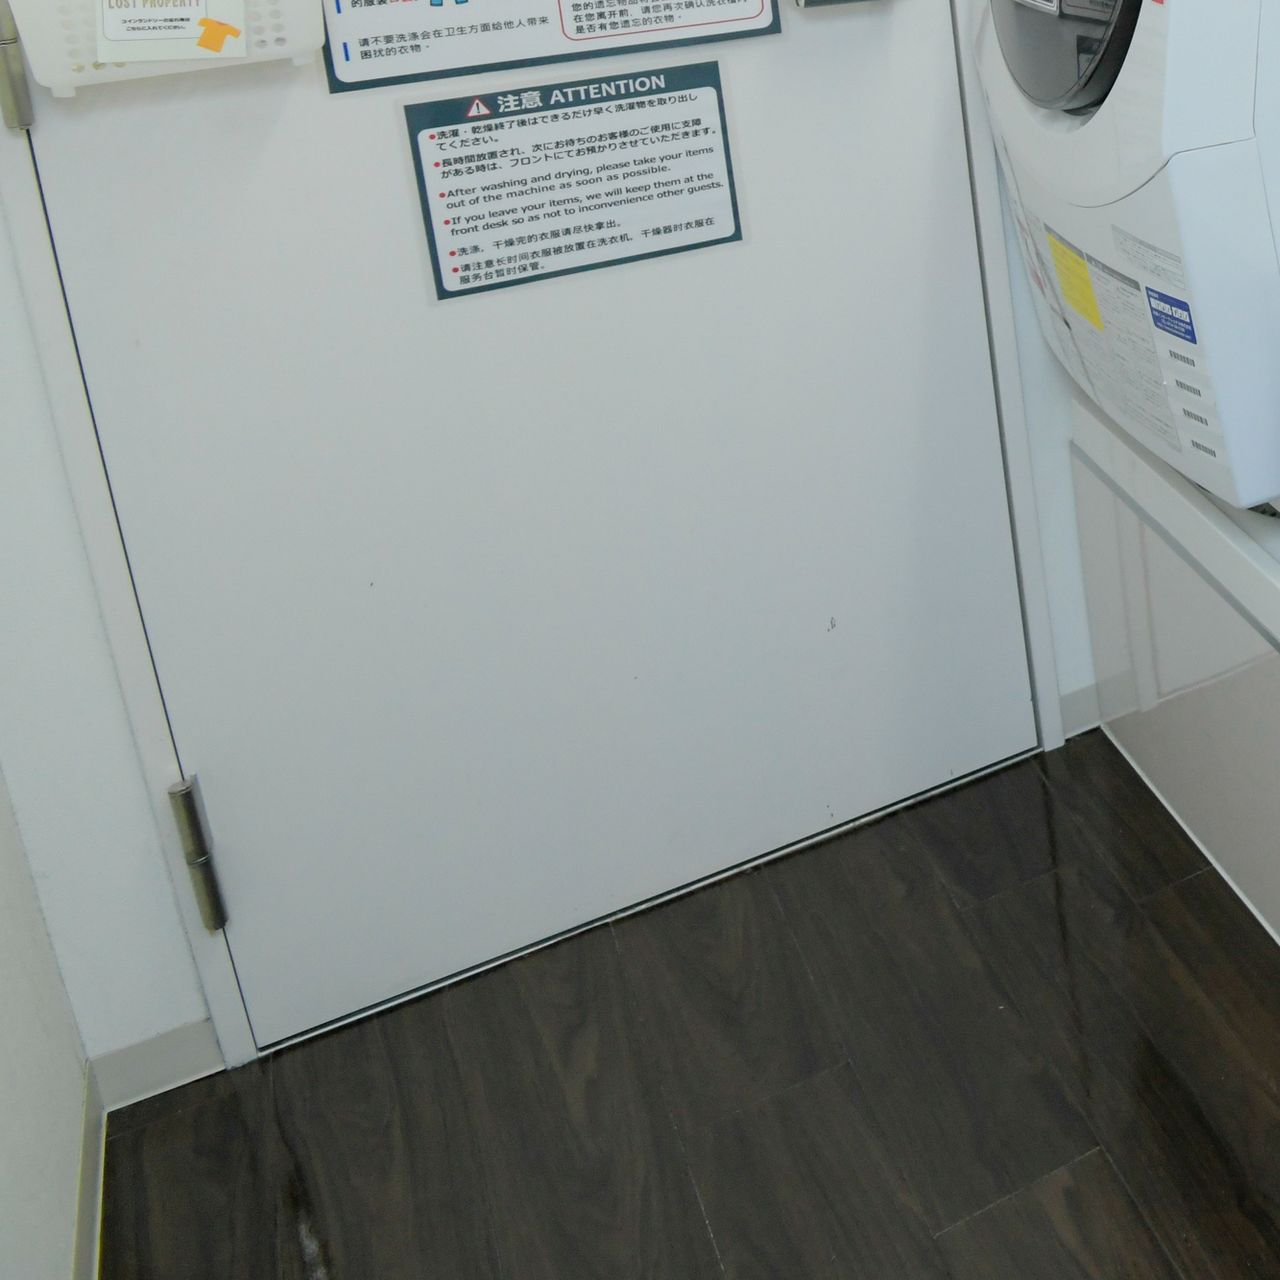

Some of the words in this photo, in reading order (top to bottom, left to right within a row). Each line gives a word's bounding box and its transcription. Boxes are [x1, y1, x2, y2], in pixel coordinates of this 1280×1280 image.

[575, 14, 682, 34] 是否有您遗忘的衣物。
[360, 44, 430, 60] 困扰的衣物。
[497, 90, 543, 112] 注意
[550, 75, 666, 105] ATTENTION
[447, 187, 476, 198] After
[481, 178, 527, 192] washing
[531, 172, 551, 183] and
[554, 166, 593, 180] drying,
[596, 160, 630, 173] please
[633, 156, 656, 166] take
[659, 152, 682, 162] your
[686, 147, 714, 157] items
[447, 200, 466, 209] out
[469, 197, 480, 205] of
[484, 193, 502, 202] the
[507, 184, 555, 198] machine
[576, 176, 603, 188] soon
[623, 165, 670, 180] possible.
